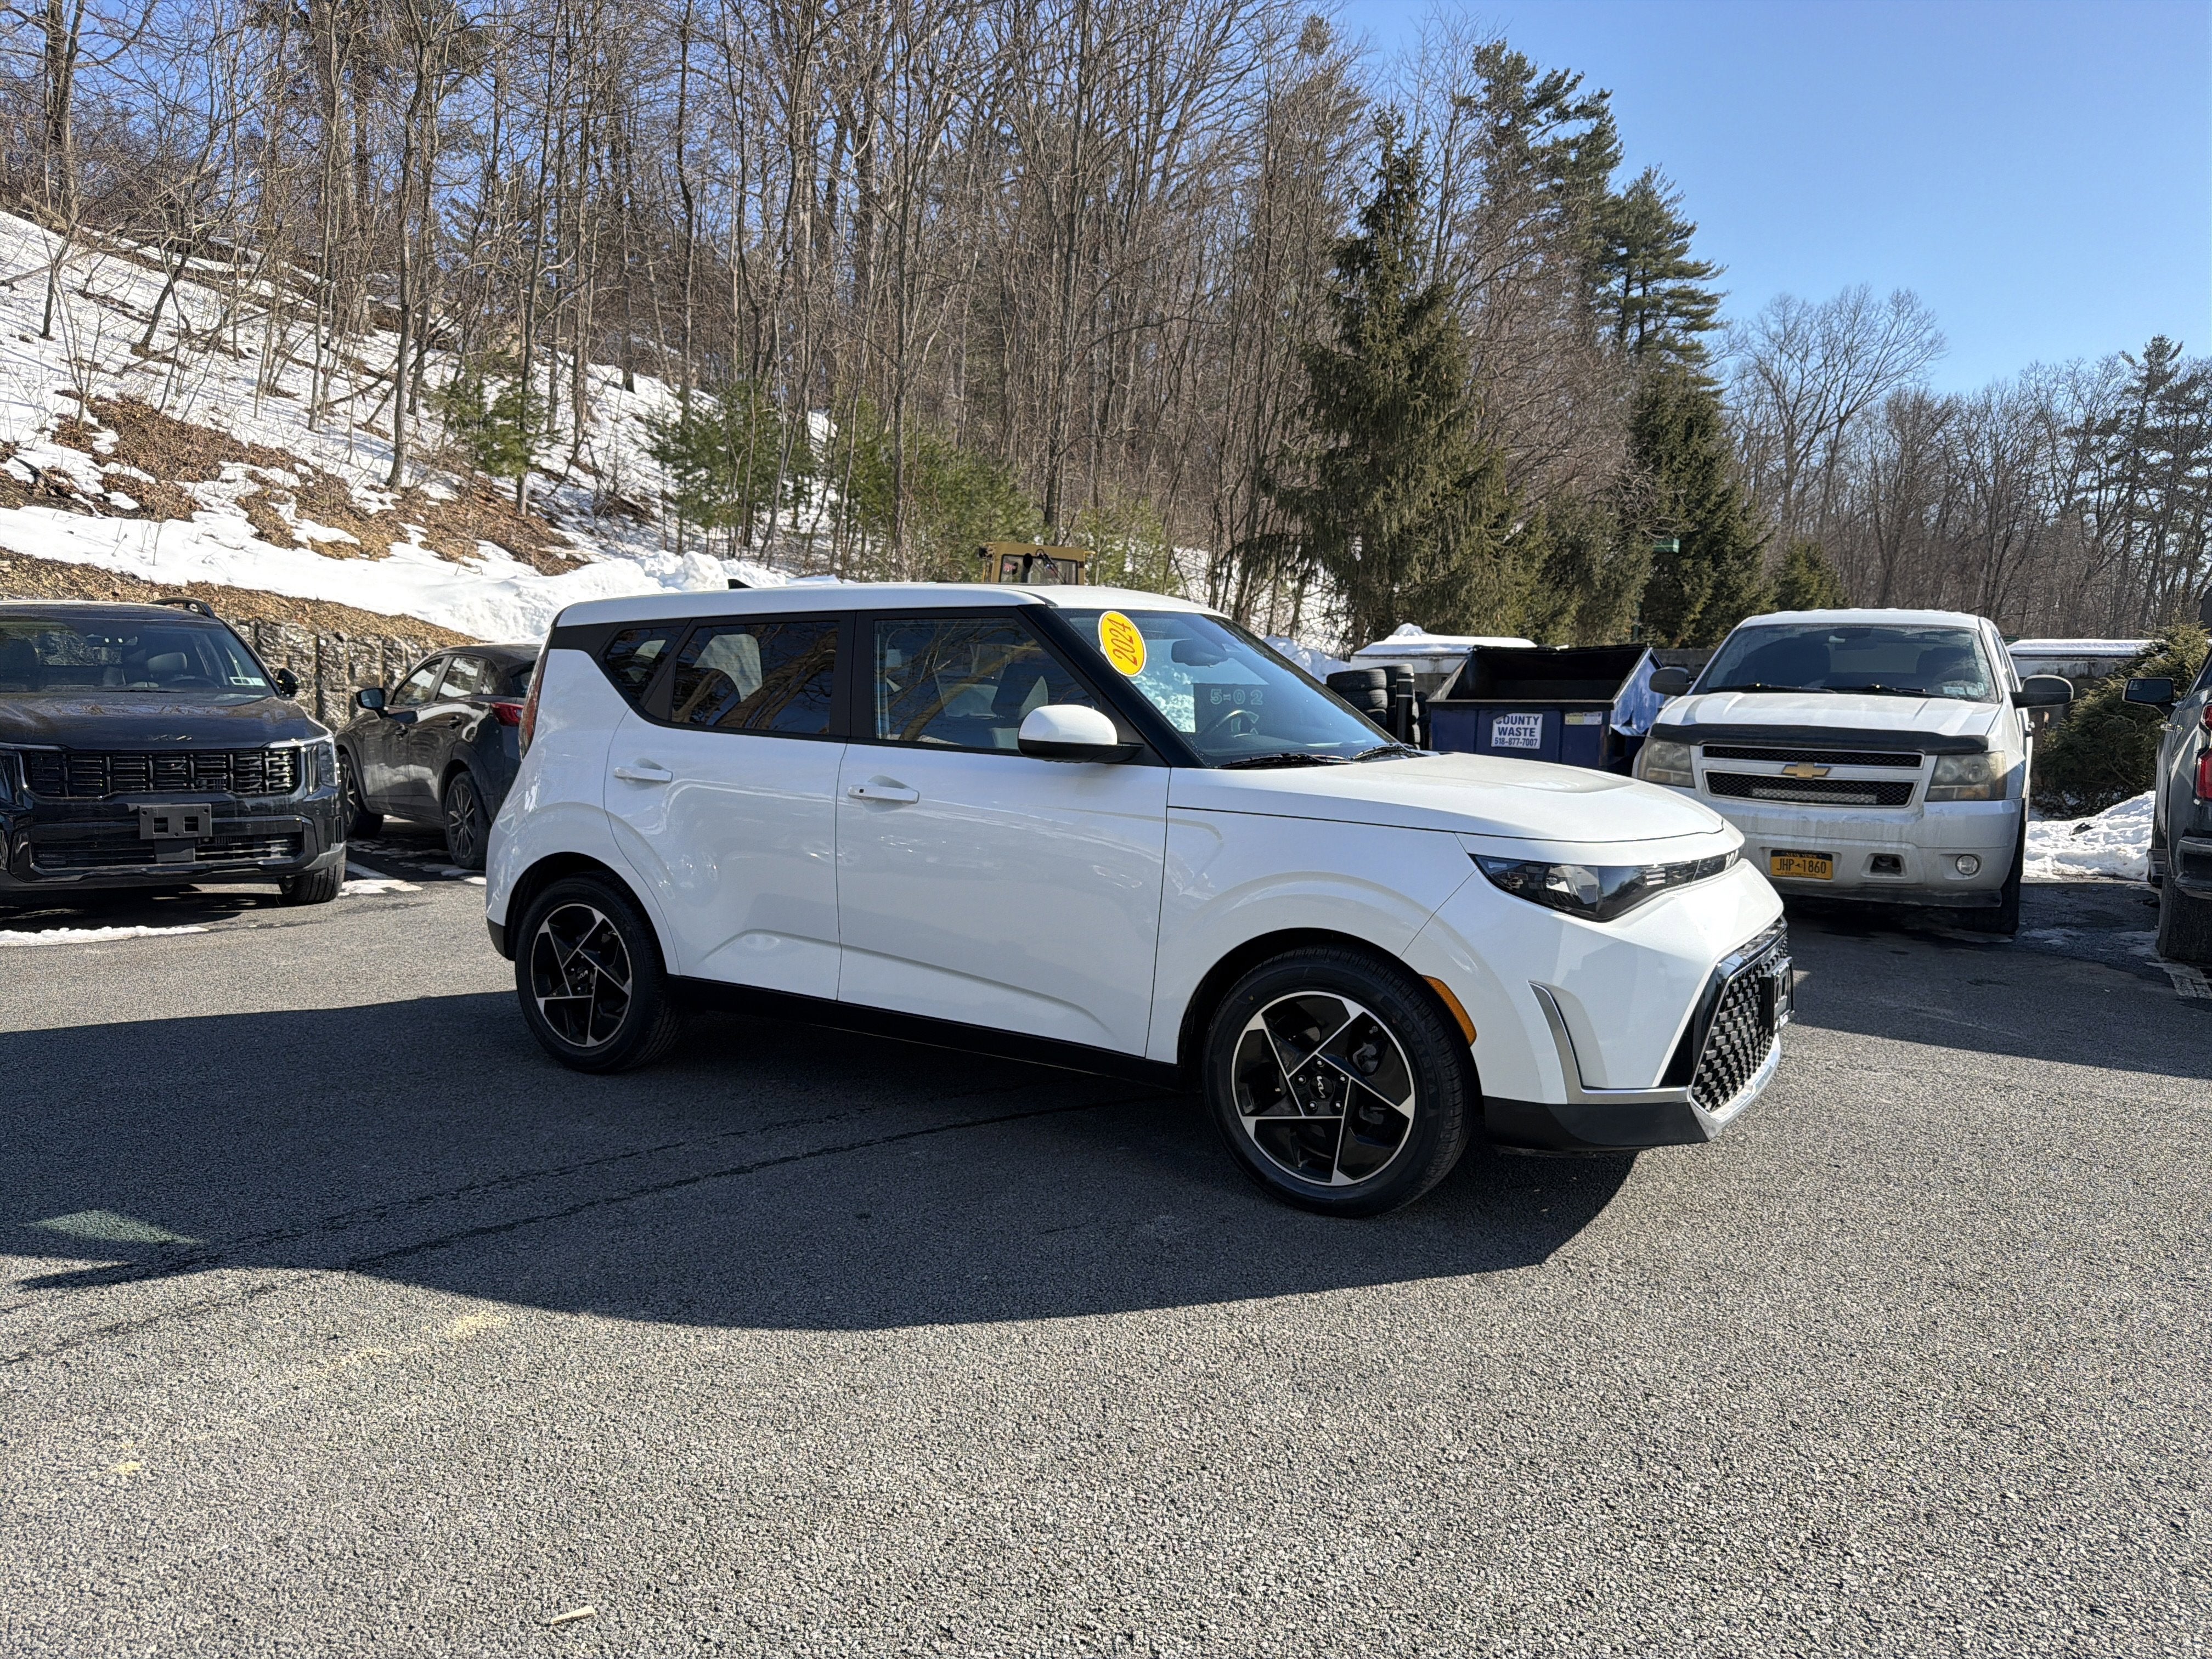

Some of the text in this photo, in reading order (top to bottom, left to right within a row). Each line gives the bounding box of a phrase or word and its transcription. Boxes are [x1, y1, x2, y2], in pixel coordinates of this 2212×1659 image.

[1107, 618, 1137, 666] 2024
[1498, 726, 1536, 737] WASTE
[1494, 737, 1538, 746] 518-877-7007
[1776, 859, 1826, 873] JHP 1860
[1317, 1076, 1326, 1098] KIA
